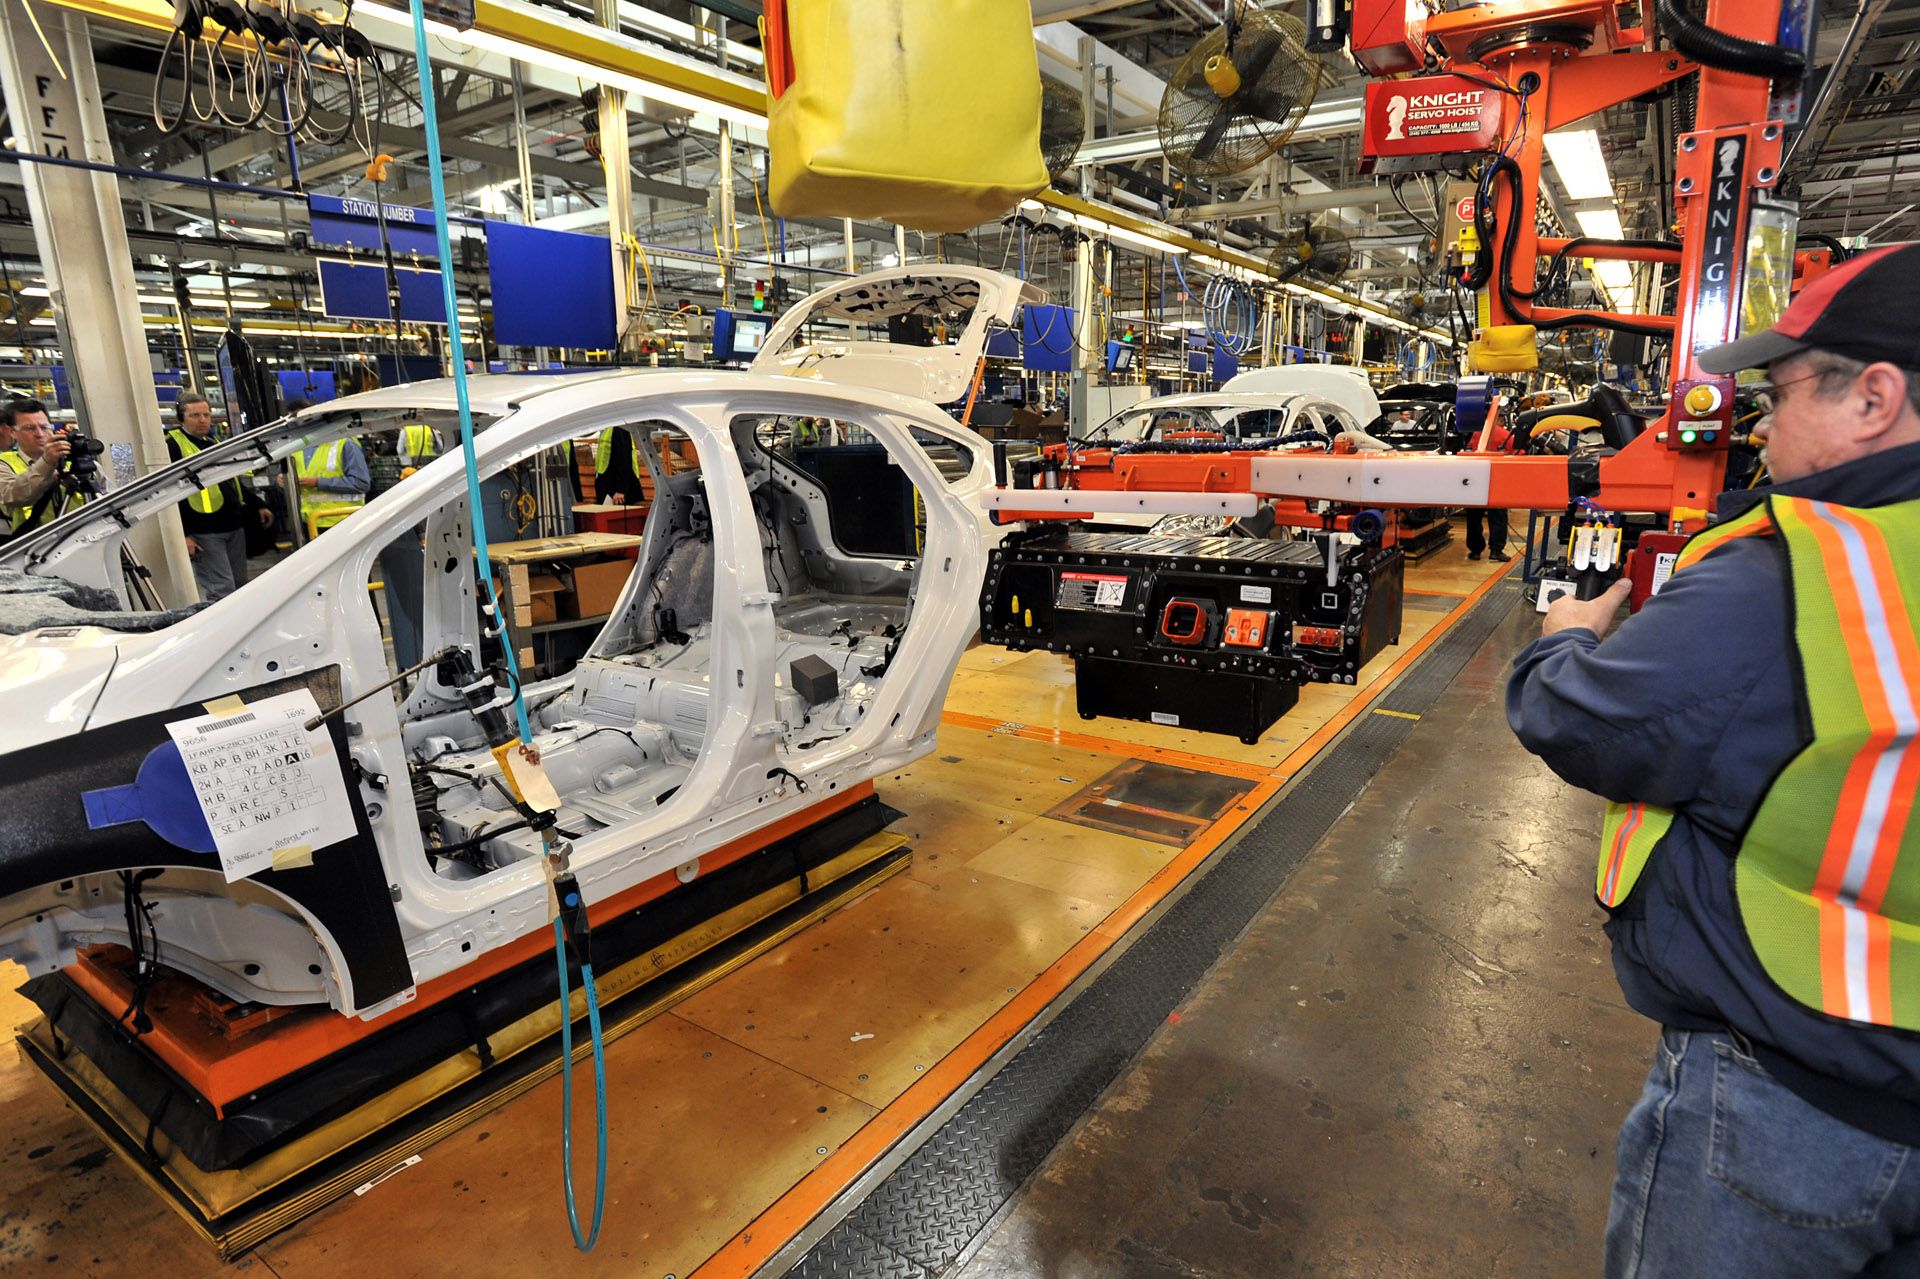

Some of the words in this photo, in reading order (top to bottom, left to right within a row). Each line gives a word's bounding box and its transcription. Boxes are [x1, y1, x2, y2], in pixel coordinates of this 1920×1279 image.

[1408, 110, 1445, 120] SERVO
[1447, 107, 1483, 117] HOIST
[1410, 91, 1484, 108] KNIGHT
[342, 200, 378, 218] STATION
[383, 206, 416, 222] NUMBER
[182, 735, 207, 747] 9656
[285, 708, 306, 719] 1692
[192, 764, 208, 775] KB
[213, 758, 227, 769] AP
[231, 754, 242, 764] B
[244, 748, 260, 760] BH
[263, 743, 279, 754] 3K
[293, 736, 302, 746] E
[199, 780, 212, 791] 2W
[216, 776, 223, 785] A
[244, 765, 258, 776] YZ
[264, 762, 272, 771] A
[274, 758, 283, 768] D
[286, 754, 297, 765] A
[300, 750, 311, 761] 16
[204, 796, 213, 806] M
[216, 793, 226, 803] B
[253, 781, 260, 791] C
[269, 776, 278, 786] C
[296, 768, 302, 777] J
[210, 811, 218, 821] P
[230, 806, 238, 815] N
[240, 802, 249, 812] R
[252, 798, 260, 808] E
[280, 788, 288, 798] S
[221, 823, 234, 835] SE
[239, 820, 246, 829] A
[254, 811, 272, 823] NW
[275, 807, 281, 816] P
